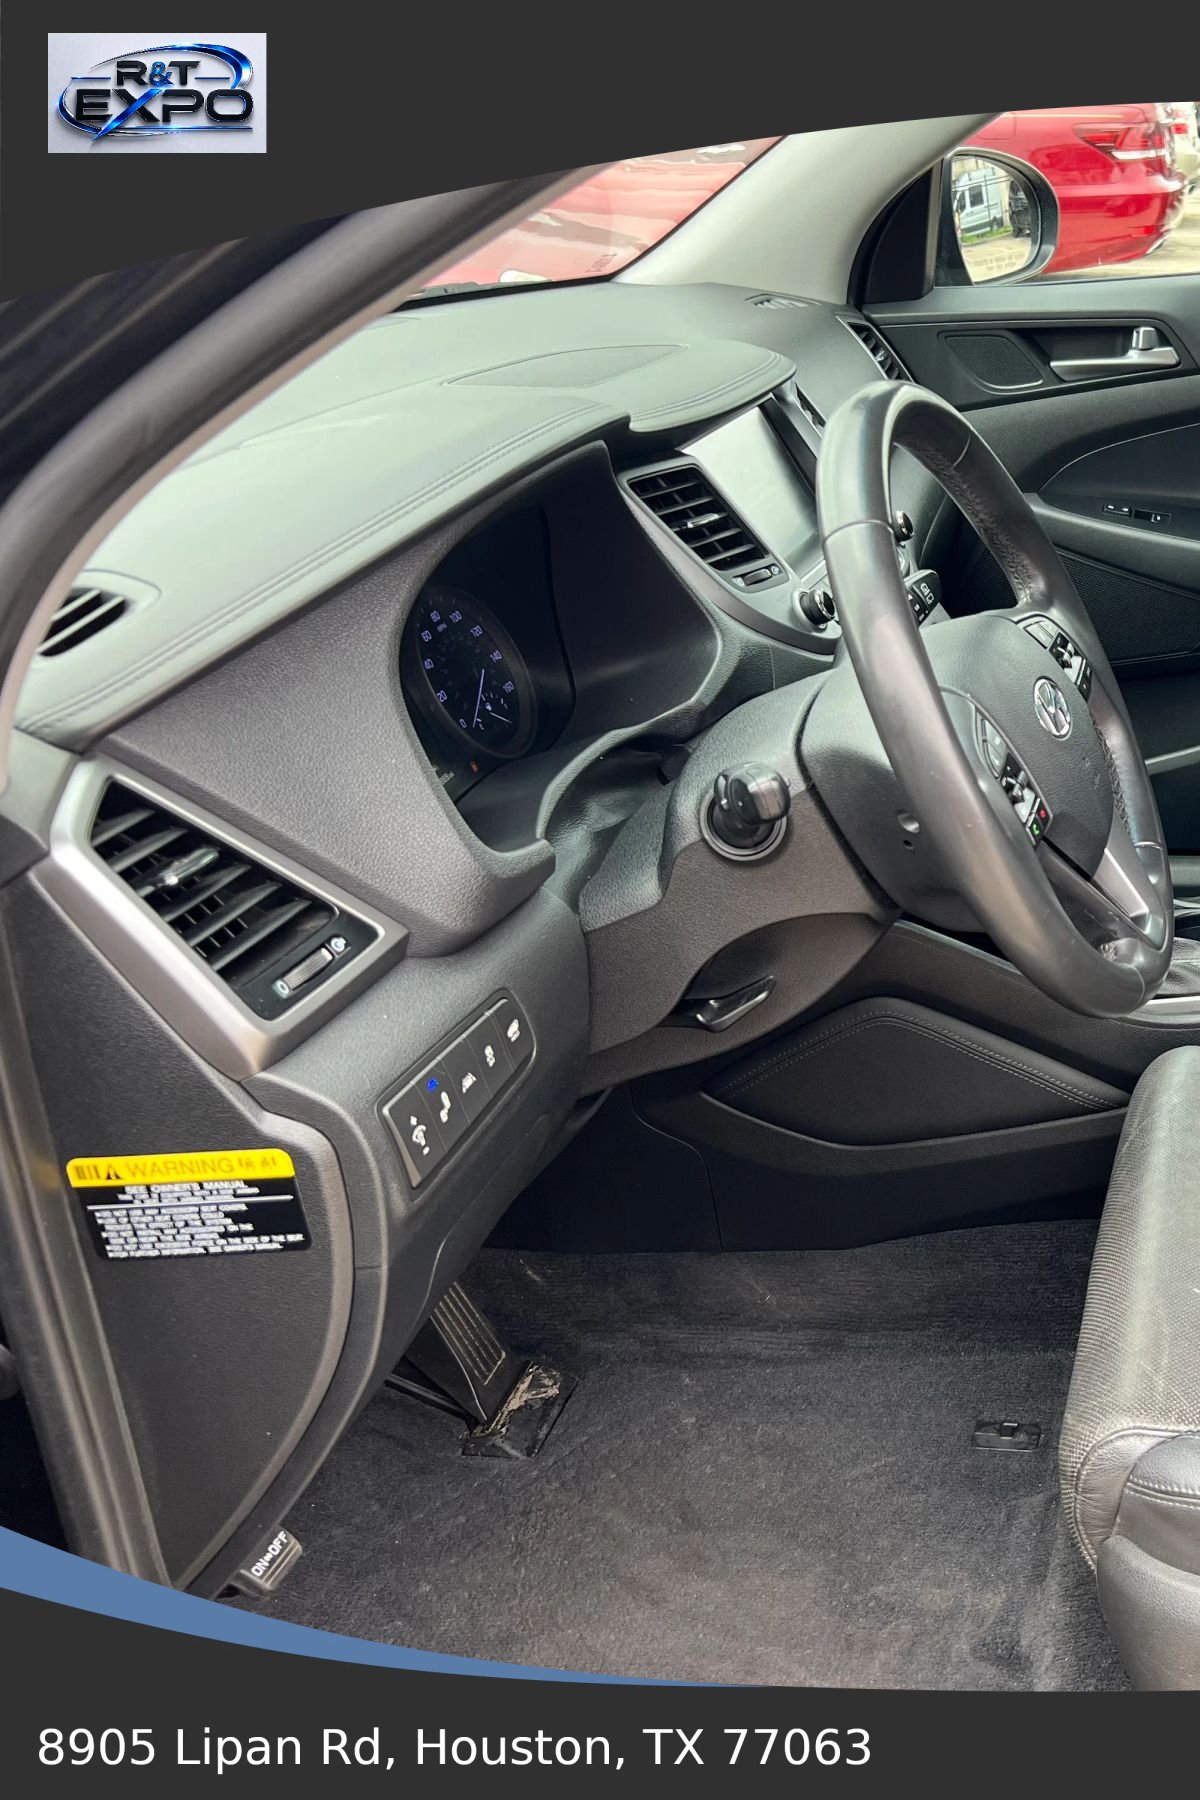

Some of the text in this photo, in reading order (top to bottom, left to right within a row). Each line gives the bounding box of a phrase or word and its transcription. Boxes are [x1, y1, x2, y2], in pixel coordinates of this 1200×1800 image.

[449, 610, 462, 623] 100
[470, 625, 482, 638] 120
[489, 650, 502, 663] 140
[126, 1157, 235, 1179] WARNING
